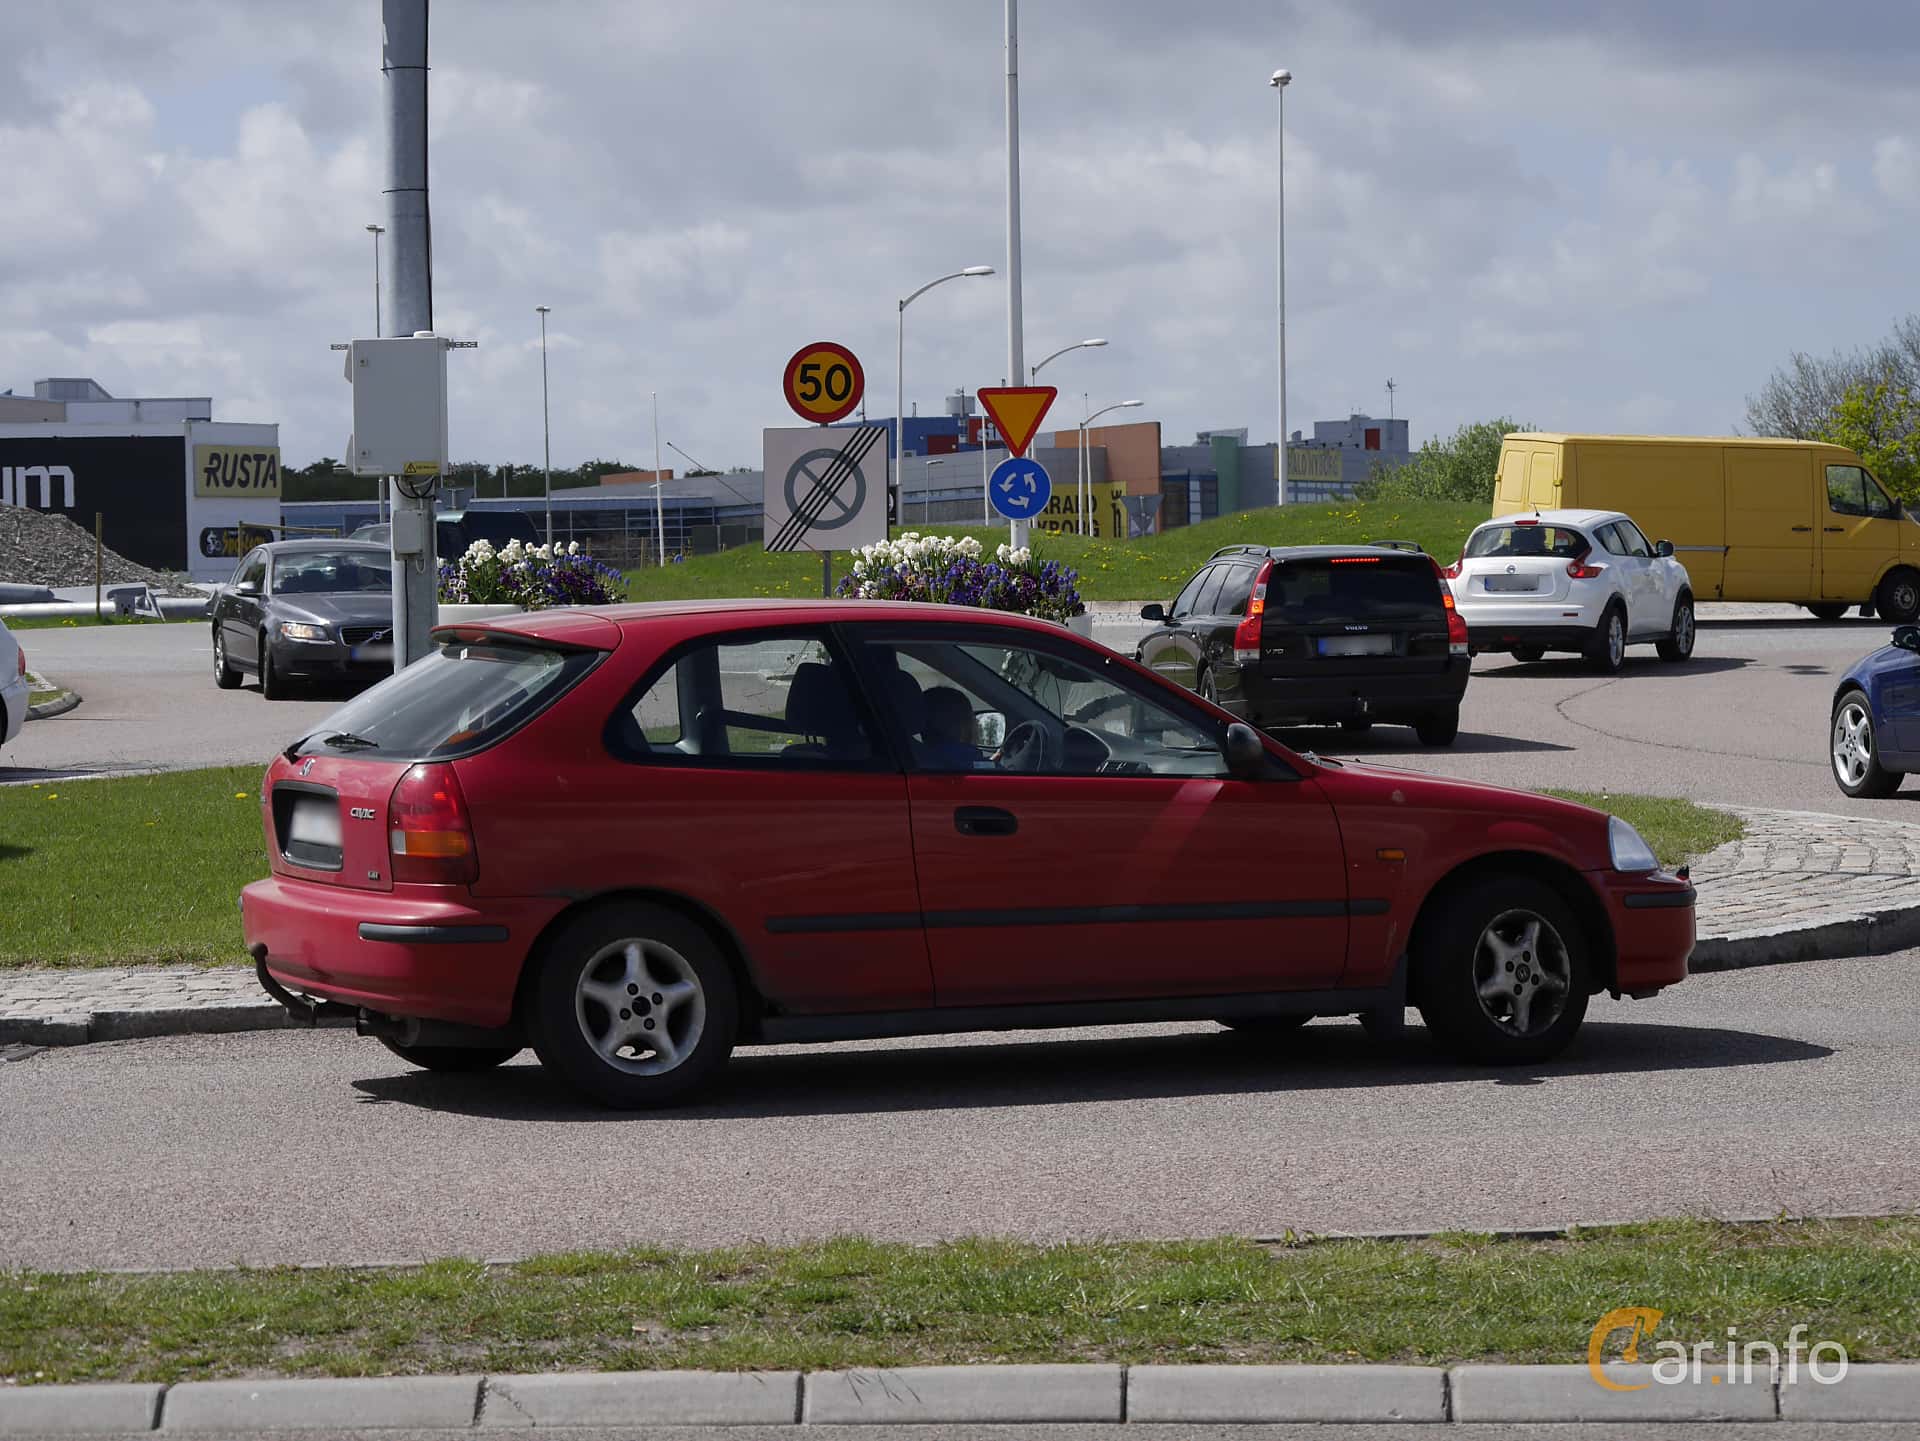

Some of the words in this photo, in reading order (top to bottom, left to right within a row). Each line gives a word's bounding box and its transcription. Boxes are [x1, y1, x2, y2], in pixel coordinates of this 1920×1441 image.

[800, 363, 852, 402] 50
[203, 452, 278, 489] RUSTA
[350, 807, 376, 819] CIVIC
